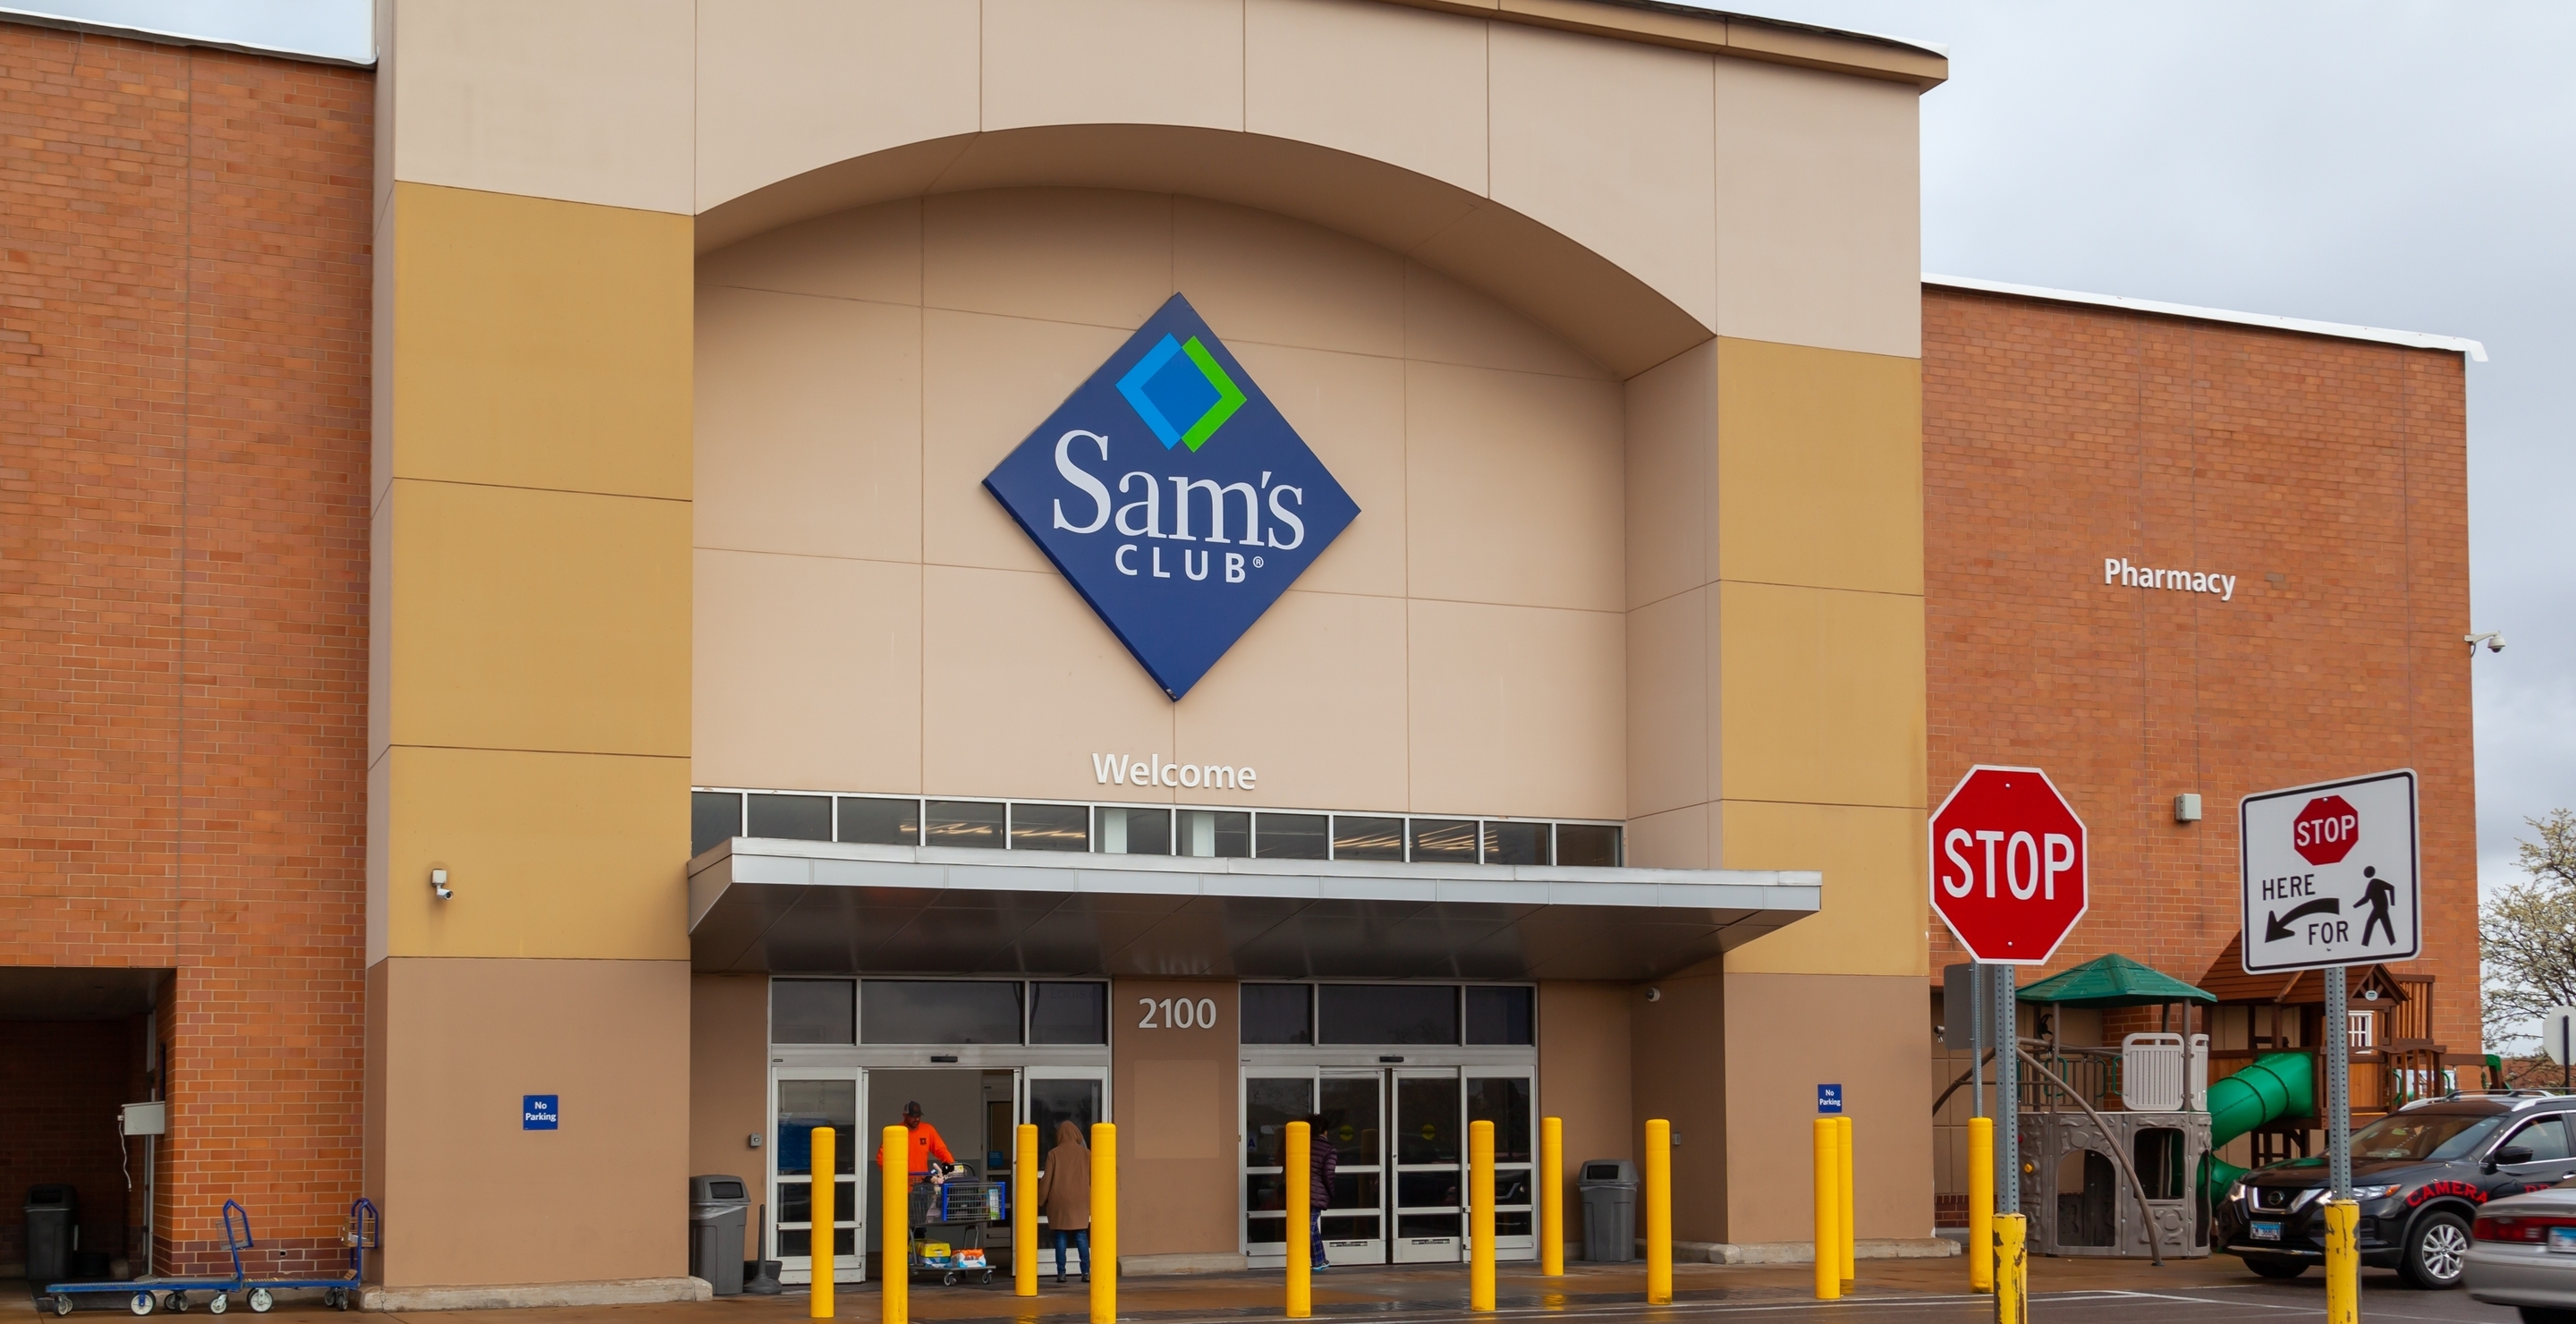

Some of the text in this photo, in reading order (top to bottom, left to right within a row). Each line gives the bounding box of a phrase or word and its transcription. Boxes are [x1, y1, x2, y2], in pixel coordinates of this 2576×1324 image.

[1053, 429, 1305, 550] Sam's
[2105, 557, 2236, 602] Pharmacy
[1091, 752, 1257, 791] Welcome
[2296, 814, 2356, 847] STOP
[1942, 828, 2075, 901] STOP
[2262, 873, 2316, 901] HERE
[2308, 921, 2349, 946] FOR
[1138, 997, 1216, 1029] 2100
[534, 1101, 547, 1110] No
[1819, 1098, 1842, 1107] Parking
[1825, 1089, 1835, 1097] No
[525, 1112, 557, 1123] Parking
[2406, 1179, 2488, 1208] CAMERA
